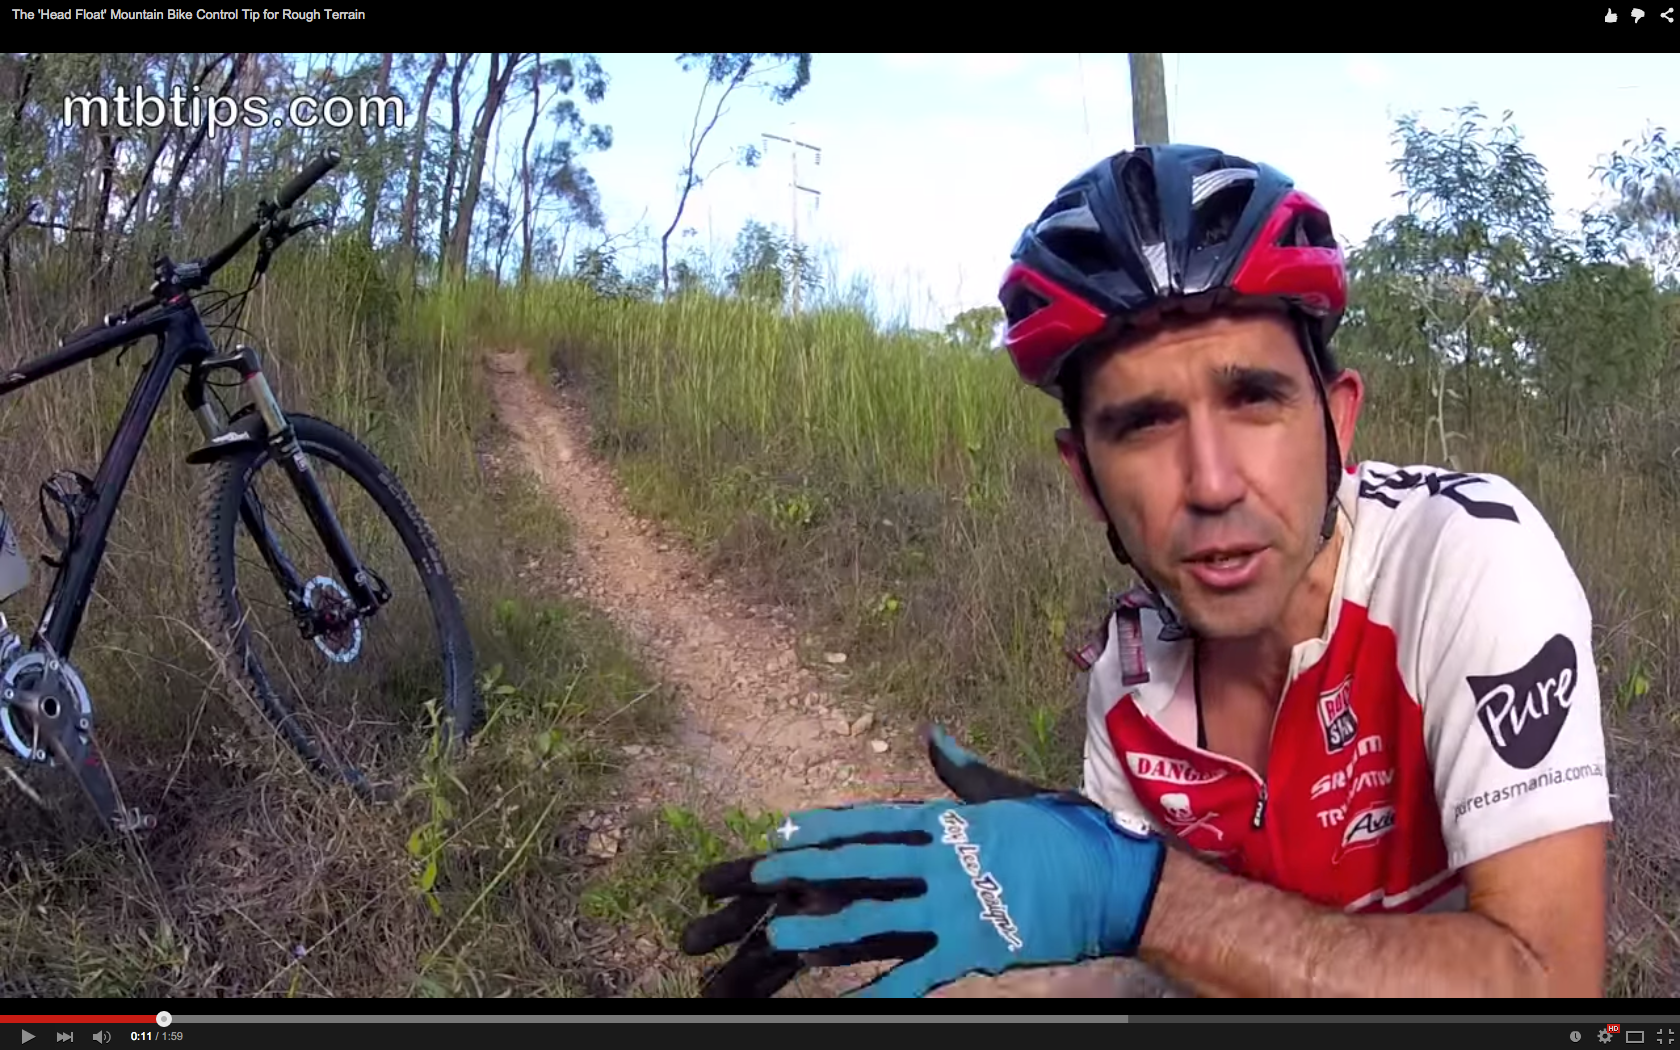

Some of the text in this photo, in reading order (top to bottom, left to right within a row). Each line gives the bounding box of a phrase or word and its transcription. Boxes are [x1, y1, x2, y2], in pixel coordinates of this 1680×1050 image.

[1476, 668, 1573, 747] Pure
[939, 810, 969, 844] Troy
[955, 844, 981, 877] Lee
